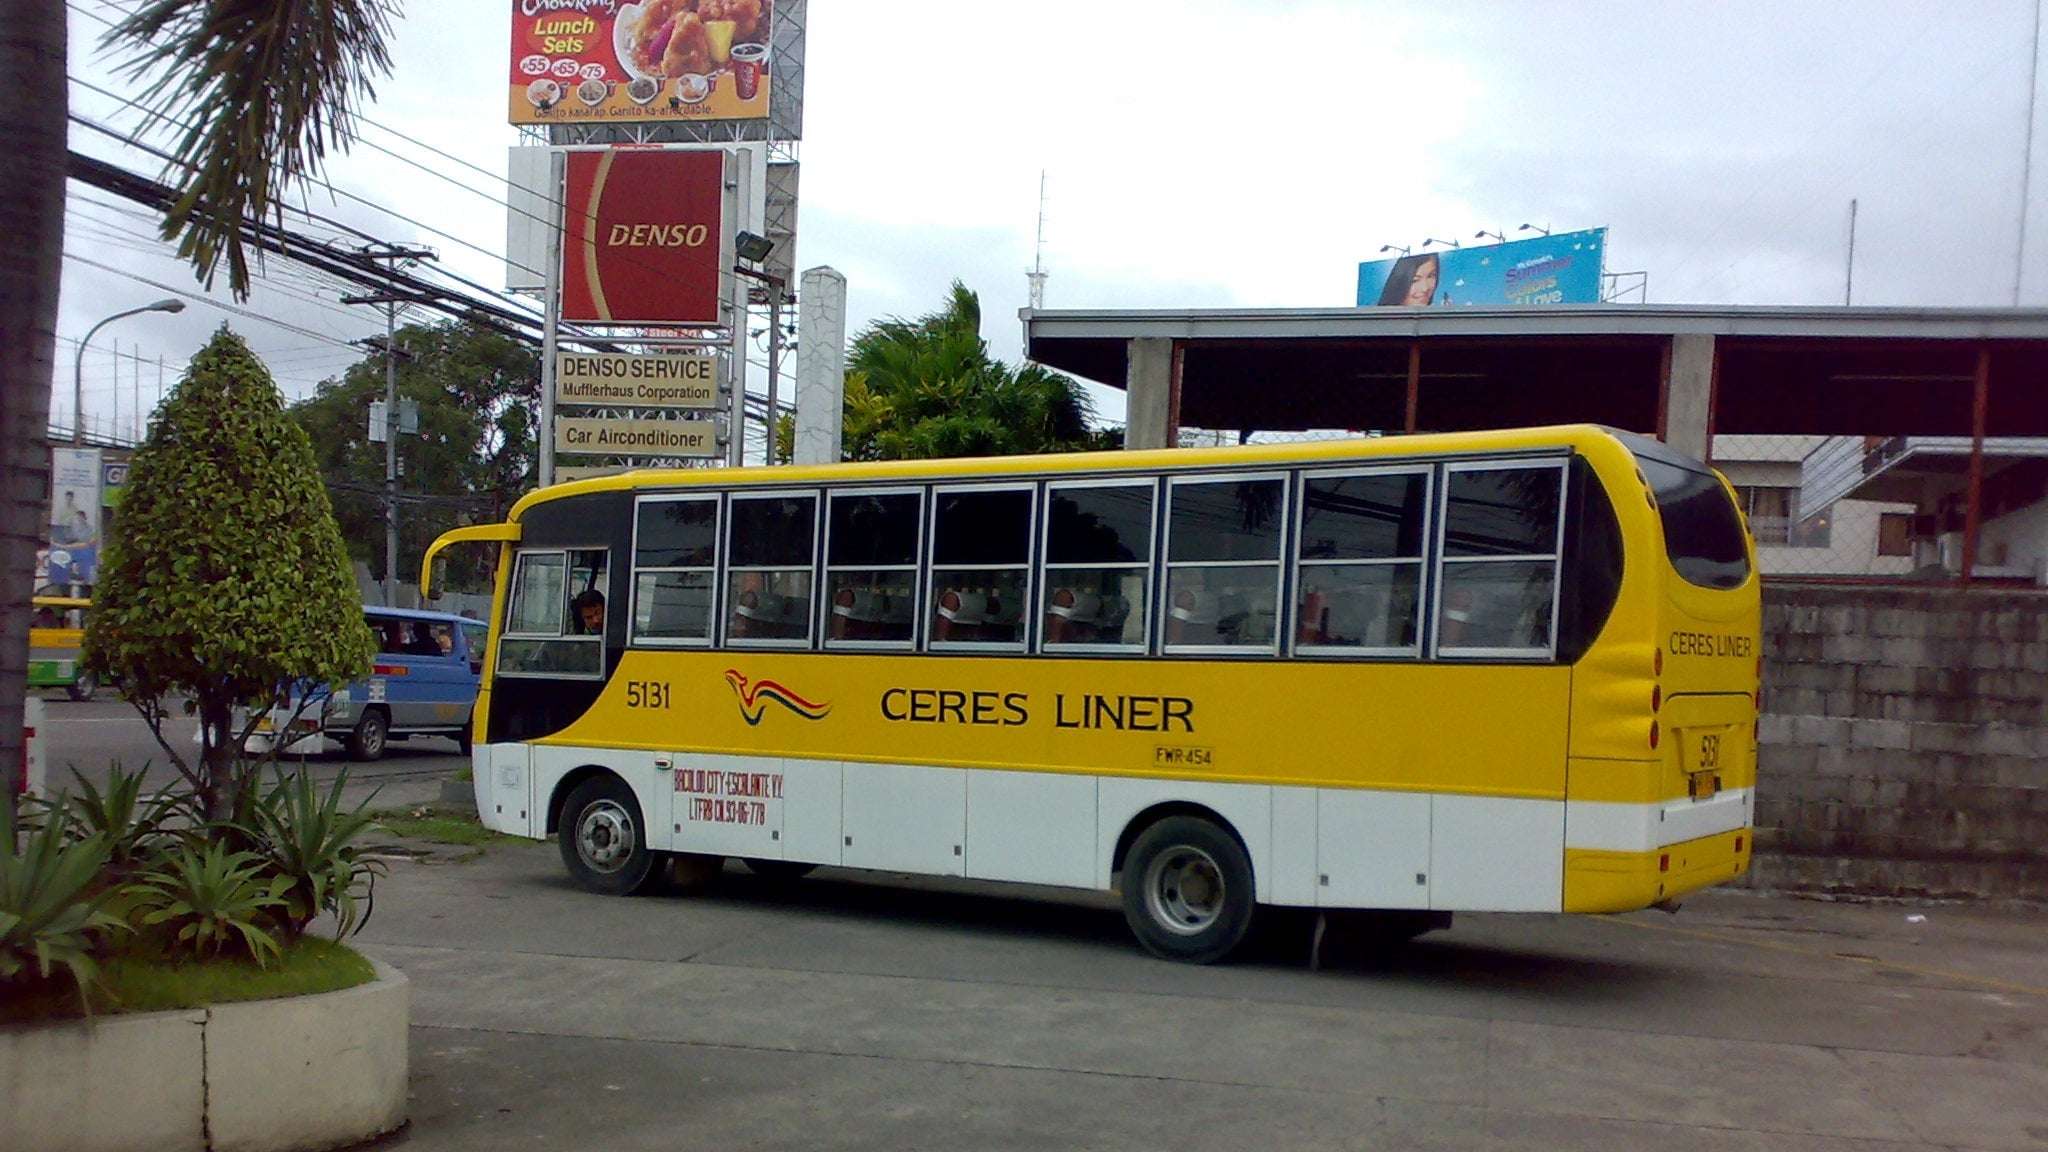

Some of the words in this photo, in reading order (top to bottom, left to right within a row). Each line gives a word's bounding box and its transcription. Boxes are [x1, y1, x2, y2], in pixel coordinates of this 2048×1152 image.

[534, 17, 595, 35] Lunch
[543, 36, 584, 54] Sets
[608, 224, 708, 246] DENSO
[564, 357, 627, 378] DENSO
[631, 360, 710, 379] SERVICE
[563, 383, 633, 398] Mufflerhaus
[637, 385, 710, 400] Corporation
[567, 428, 592, 443] Car
[598, 429, 704, 447] Airconditioner
[1670, 631, 1713, 657] CERES
[1716, 635, 1751, 657] LINER
[627, 681, 670, 709] 5131
[881, 688, 1029, 726] CERES
[1055, 694, 1194, 733] LINER
